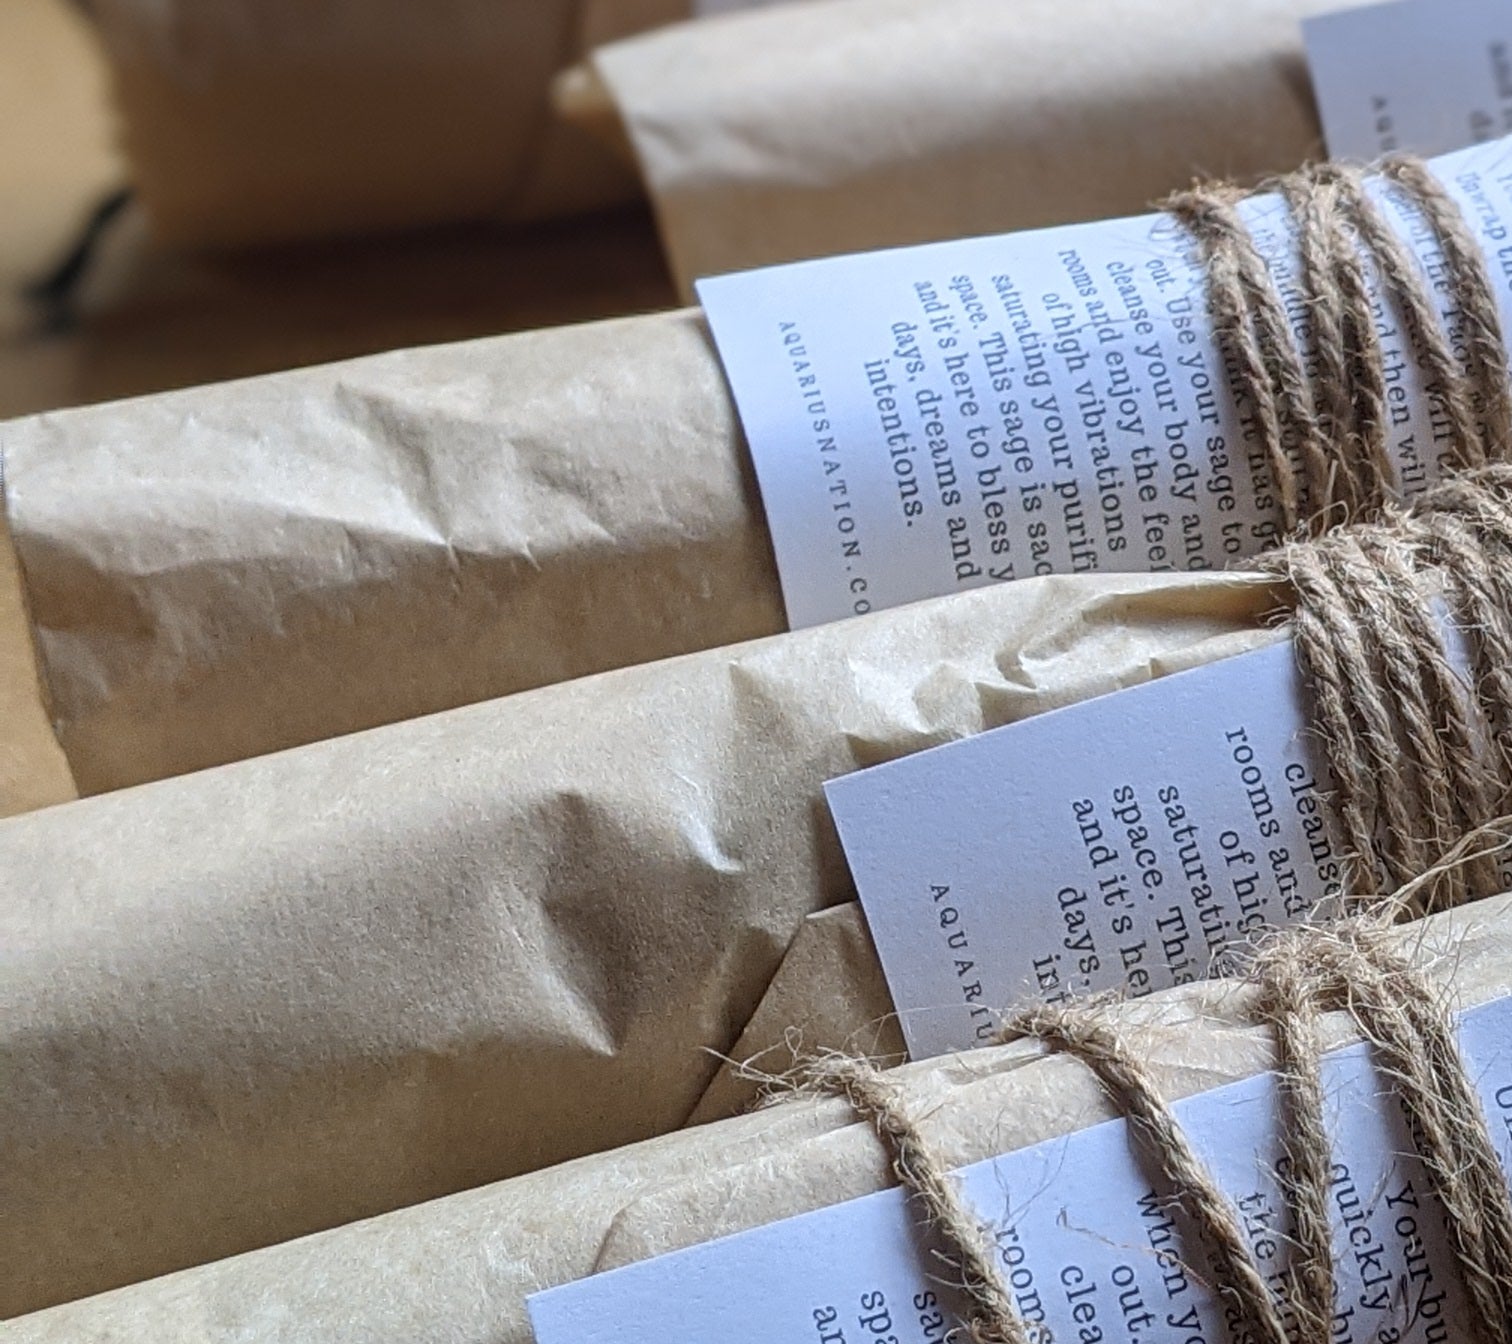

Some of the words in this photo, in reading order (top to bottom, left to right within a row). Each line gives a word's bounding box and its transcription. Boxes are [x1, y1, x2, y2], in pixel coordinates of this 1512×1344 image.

[1042, 293, 1064, 320] of
[1146, 258, 1167, 293] out.
[1165, 295, 1197, 347] Use
[944, 351, 980, 418] here
[951, 274, 988, 330] space.
[979, 331, 1013, 394] This
[1000, 400, 1035, 475] sage
[1020, 481, 1043, 513] is
[991, 273, 1052, 389] saturating
[1032, 394, 1075, 473] your
[1052, 315, 1091, 374] high
[1059, 249, 1098, 299] rooms
[1105, 349, 1145, 440] enjoy
[1131, 443, 1158, 503] the
[1106, 261, 1153, 335] cleanse
[1138, 342, 1178, 412] your
[1165, 423, 1202, 507] body
[1179, 352, 1221, 424] your
[779, 321, 871, 616] AQUARIUSNATION.CO
[864, 359, 924, 528] intentions.
[891, 321, 926, 382] days,
[915, 388, 962, 507] dreams
[947, 517, 982, 580] and
[966, 425, 991, 459] to
[1074, 379, 1127, 553] vibrations
[1206, 435, 1238, 512] sage
[1383, 348, 1411, 427] then
[1398, 437, 1425, 497] will
[977, 465, 1011, 555] bless
[1220, 520, 1241, 555] to
[1225, 727, 1282, 838] rooms
[1072, 799, 1118, 868] and
[1098, 875, 1135, 934] it's
[1113, 784, 1165, 901] space.
[1219, 829, 1254, 867] of
[1137, 1189, 1189, 1300] when
[1331, 1164, 1395, 1312] quickly
[1385, 1180, 1434, 1290] Your
[1111, 1263, 1157, 1344] out.
